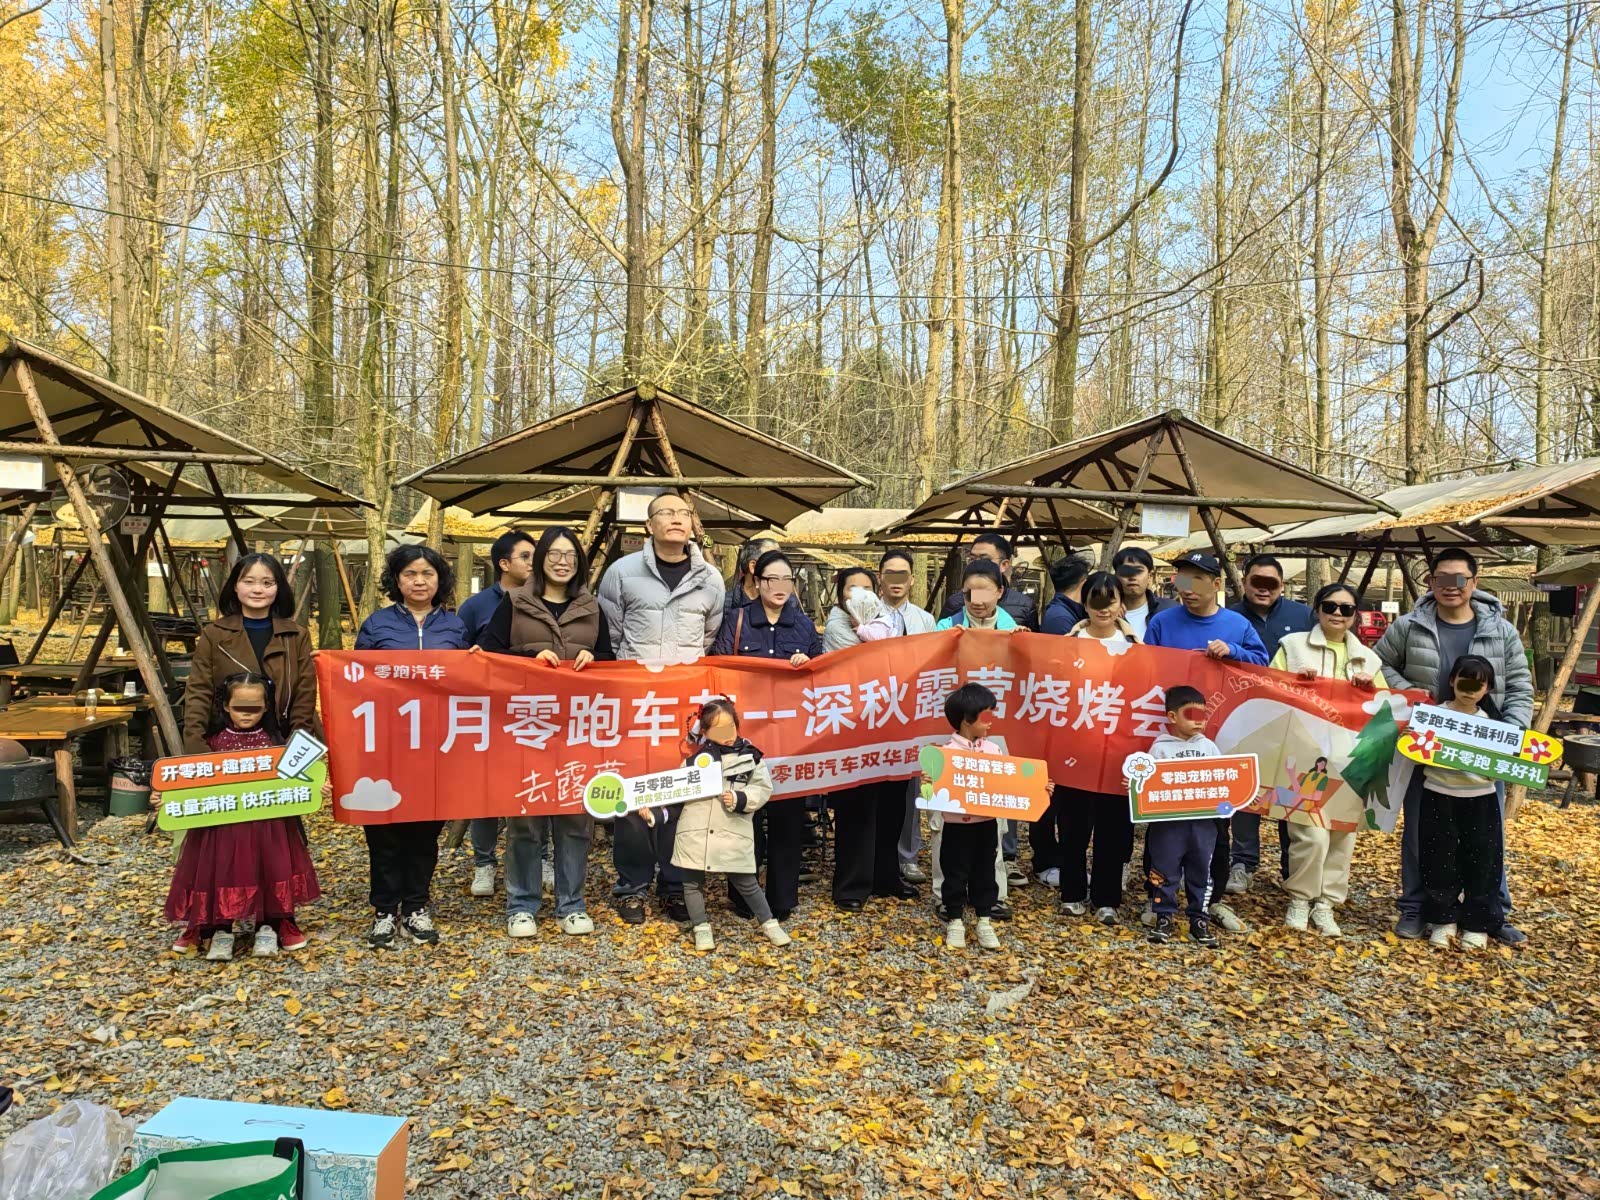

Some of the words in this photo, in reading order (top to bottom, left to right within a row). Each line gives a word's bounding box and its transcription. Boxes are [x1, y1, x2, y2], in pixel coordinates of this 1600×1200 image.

[374, 664, 447, 680] 零跑汽车
[1414, 710, 1519, 747] 零跑车主福利局
[288, 745, 311, 768] CALL
[951, 755, 1016, 775] 零跑露营季
[1441, 744, 1491, 769] 开零跑
[1494, 758, 1545, 784] 享好礼
[633, 770, 701, 793] 与零跑一起
[1161, 768, 1238, 784] 零跑宠粉带你
[165, 796, 236, 817] 电量满格
[241, 786, 311, 808] 快乐满格
[590, 785, 621, 801] Biu!
[634, 785, 702, 806] 把露营过成生活
[965, 791, 1030, 811] 向自然撒野
[1148, 786, 1230, 803] 解锁露营新姿势
